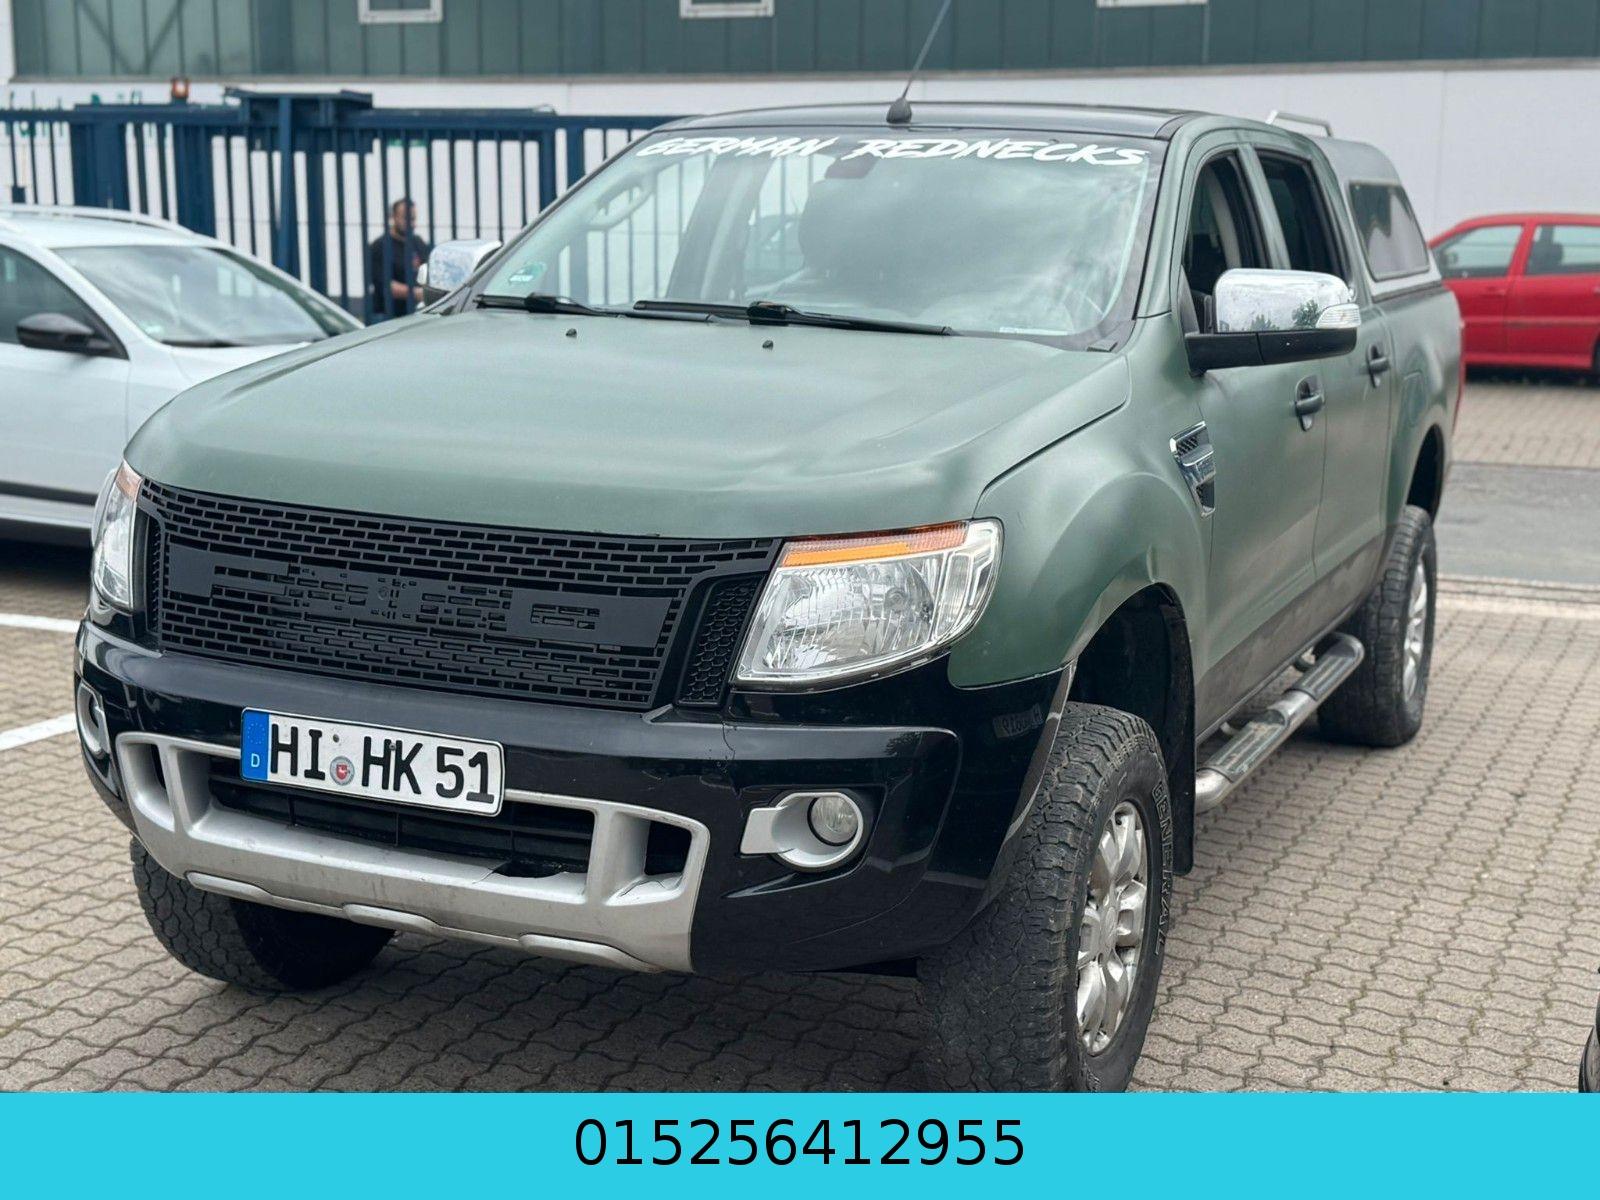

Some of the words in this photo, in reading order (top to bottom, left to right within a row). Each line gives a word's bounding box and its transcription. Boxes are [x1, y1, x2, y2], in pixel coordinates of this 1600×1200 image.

[636, 136, 840, 158] GERMAN
[841, 138, 1149, 165] REDNECKS
[250, 753, 261, 768] D
[270, 723, 326, 781] HI
[361, 735, 424, 795] HK
[435, 745, 495, 804] 51
[1151, 781, 1174, 956] GENERAL
